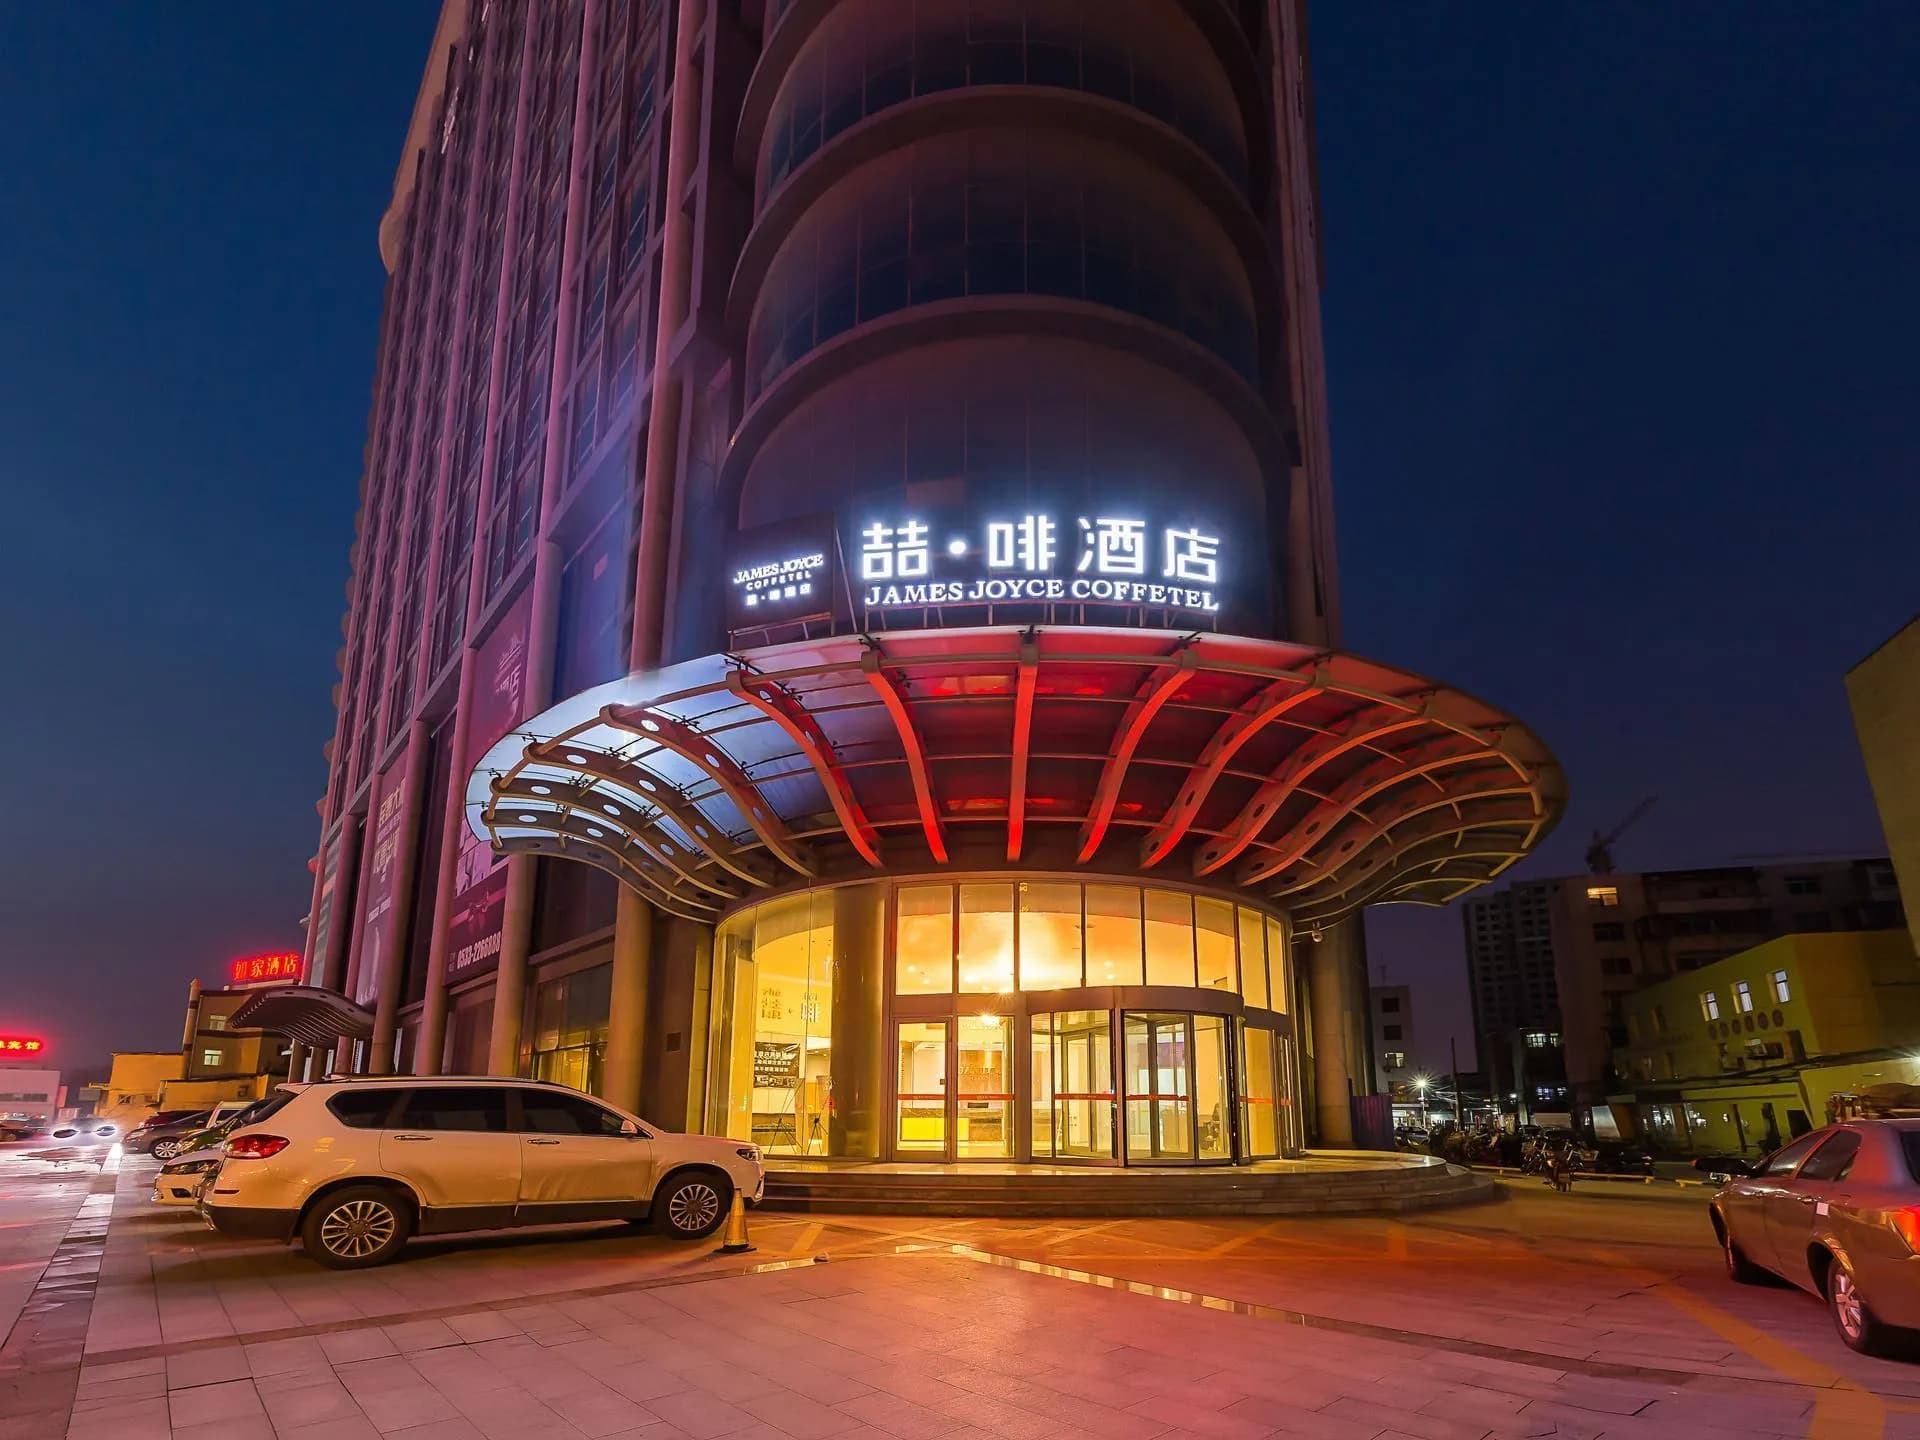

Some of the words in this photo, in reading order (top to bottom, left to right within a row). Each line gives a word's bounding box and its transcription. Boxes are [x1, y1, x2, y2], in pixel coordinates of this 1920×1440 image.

[862, 515, 1220, 583] 喆·啡酒店
[733, 563, 779, 584] JAMES
[780, 553, 824, 574] JOYCE
[746, 570, 812, 591] COFFETEL
[865, 584, 963, 607] JAMES
[969, 578, 1065, 600] JOYCE
[1072, 579, 1221, 611] COFFETEL
[234, 953, 299, 981] 如家酒店
